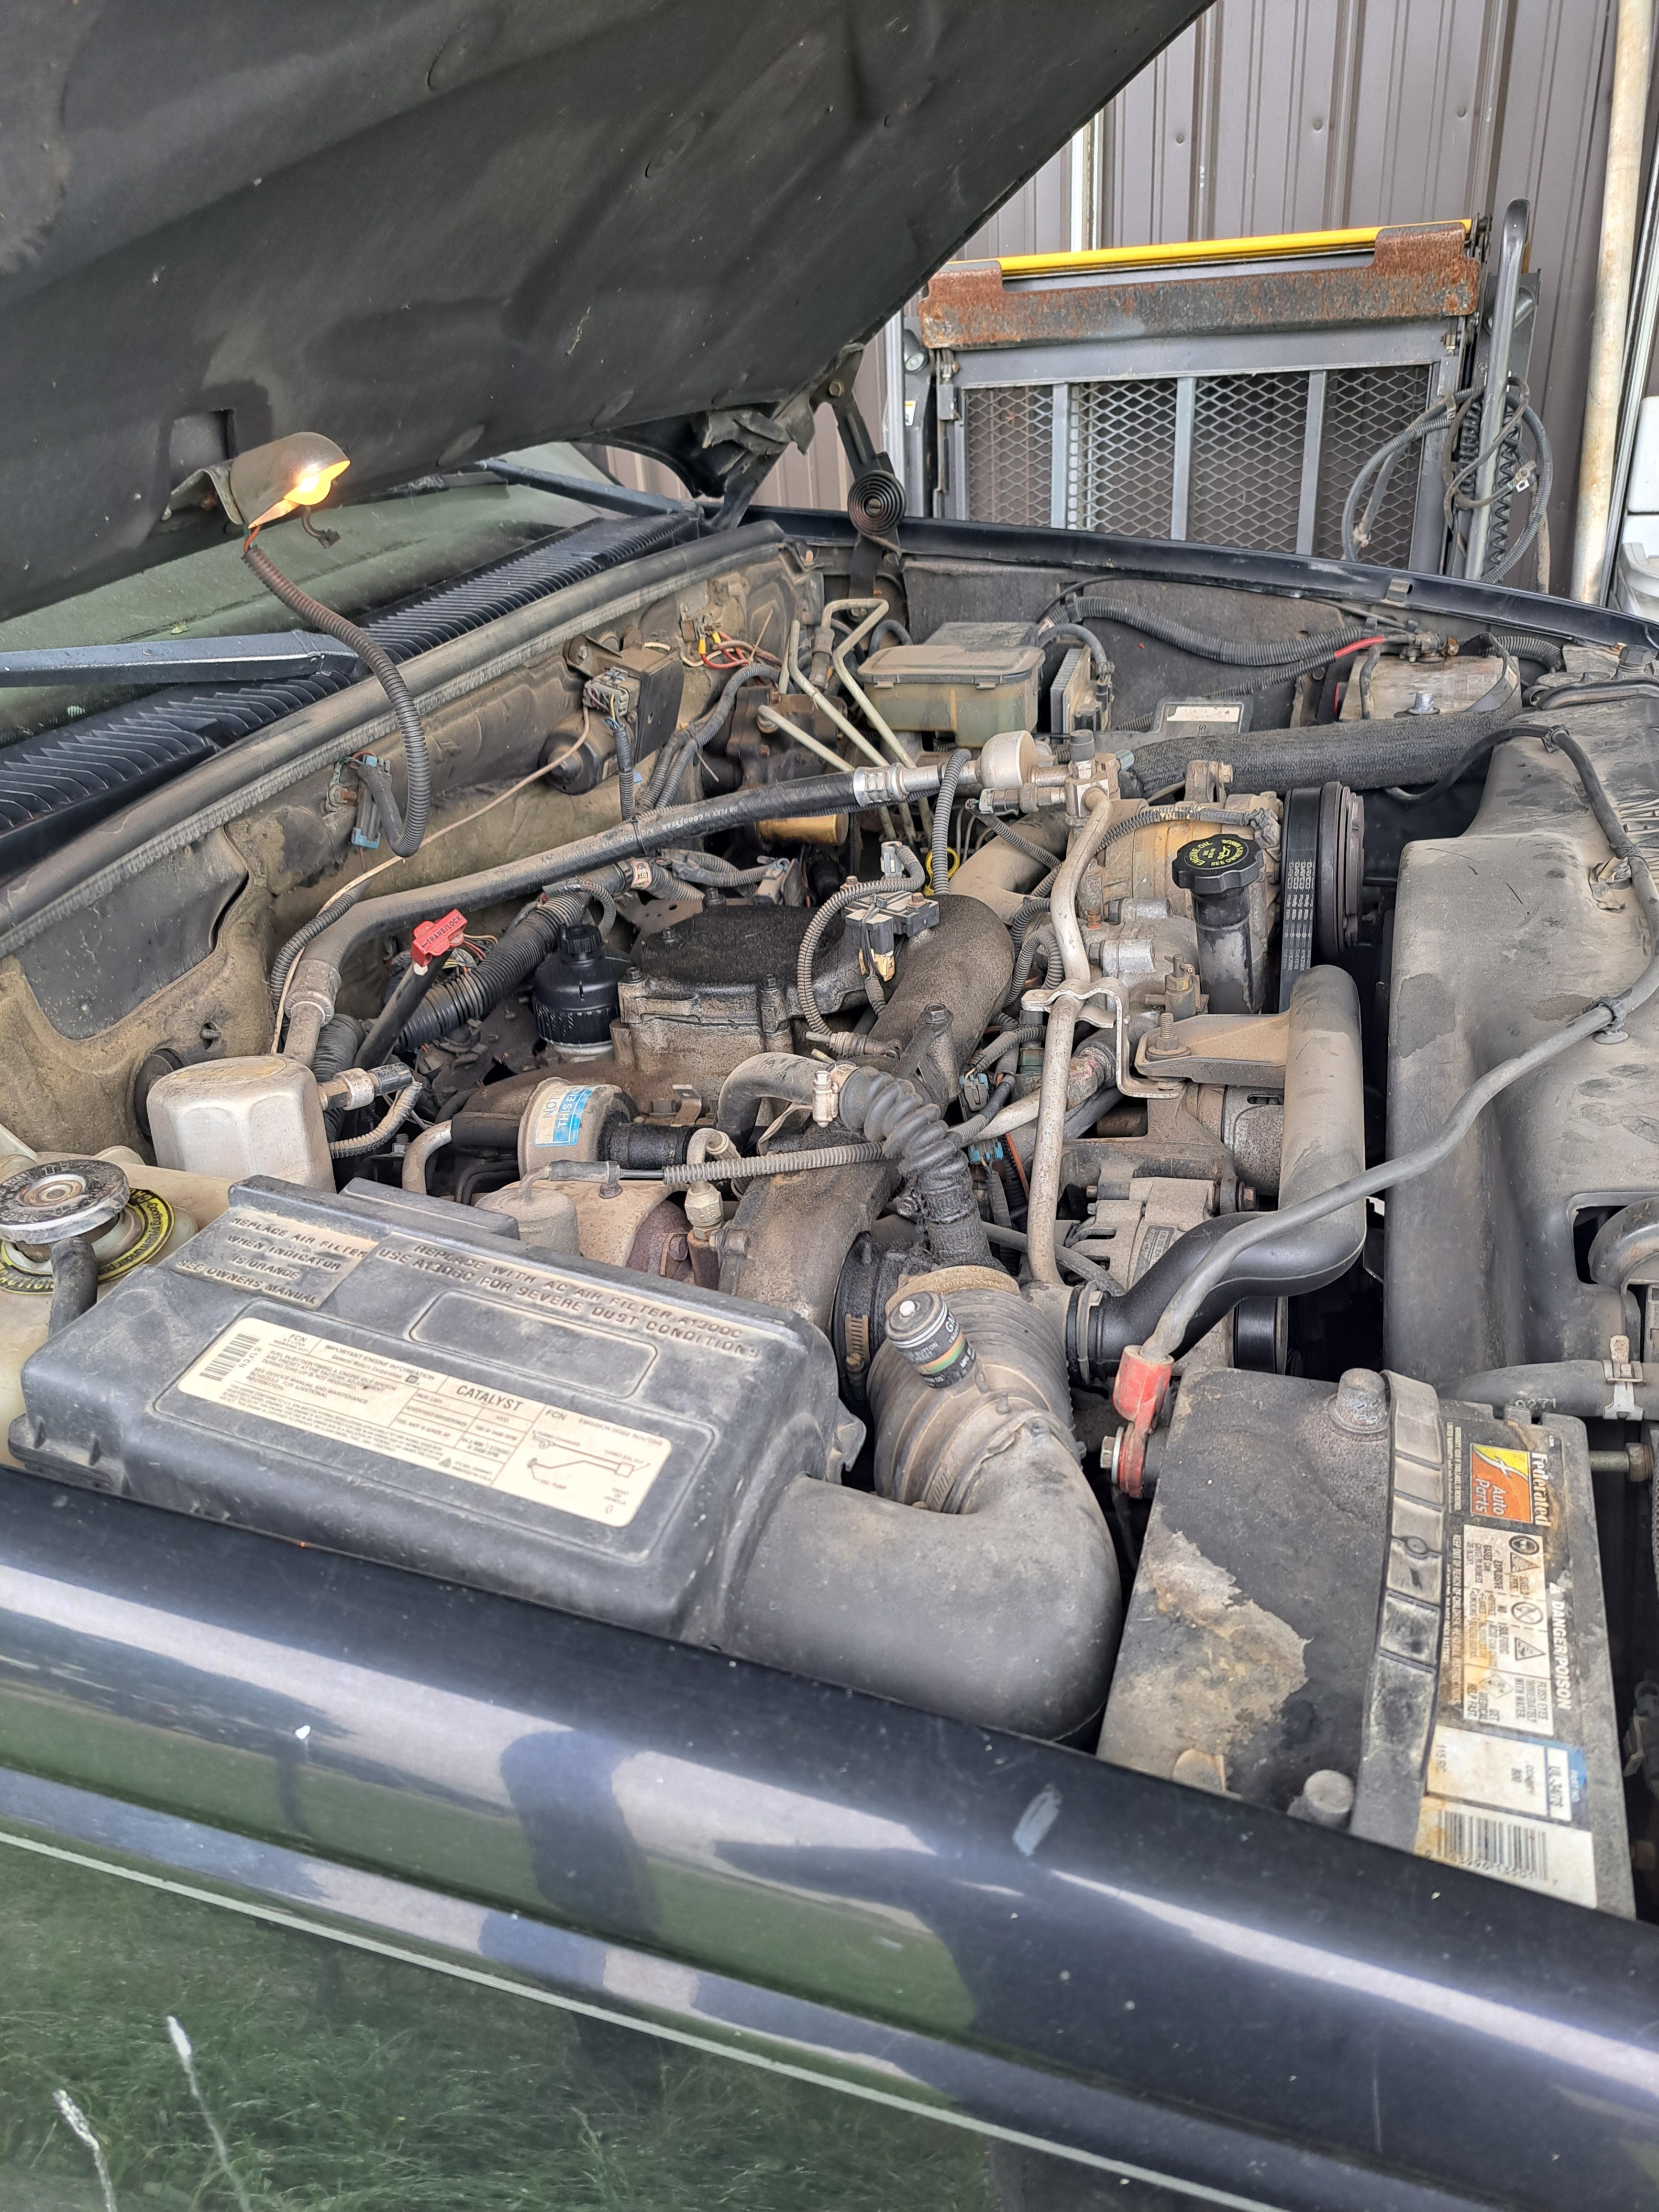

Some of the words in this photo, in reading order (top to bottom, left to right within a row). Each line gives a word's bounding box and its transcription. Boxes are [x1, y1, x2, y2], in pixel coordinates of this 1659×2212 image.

[662, 813, 704, 831] GOODYEAR
[1189, 848, 1206, 865] ENGINE
[426, 915, 463, 945] TRANS/LOCK
[557, 1104, 572, 1129] THIS
[146, 1203, 164, 1225] Cooling
[232, 1217, 288, 1237] REPLACE
[292, 1234, 315, 1245] AIR
[320, 1241, 368, 1258] FILTER
[227, 1236, 265, 1250] WHEN
[268, 1247, 341, 1270] INDICATOR
[232, 1255, 247, 1264] IS
[248, 1261, 300, 1279] ORANGE
[178, 1259, 205, 1272] SEE
[206, 1267, 263, 1288] OWNERS
[265, 1284, 317, 1304] MANUAL
[412, 1243, 487, 1270] REPLACE
[490, 1264, 537, 1284] WITH
[542, 1279, 568, 1293] AC
[574, 1286, 603, 1302] AIR
[608, 1296, 673, 1321] FILTER
[378, 1248, 412, 1264] USE
[479, 1275, 512, 1292] FOR
[516, 1285, 584, 1312] SEVERE
[590, 1305, 639, 1327] DUST
[645, 1319, 759, 1360] CONDITIONS
[288, 1333, 308, 1343] FCN
[323, 1344, 364, 1360] IMPORTANT
[362, 1356, 390, 1367] ENGINE
[388, 1363, 437, 1381] INFORMATION
[454, 1384, 525, 1412] CATALYST
[544, 1409, 568, 1420] FCN
[1474, 1478, 1490, 1513] Parts
[1492, 1485, 1508, 1515] Auto
[1531, 1452, 1552, 1527] Federated
[1483, 1544, 1492, 1561] GASES
[1493, 1559, 1503, 1590] EXPLOSIVE
[1519, 1576, 1529, 1595] SHIELD
[1498, 1604, 1506, 1613] NO
[1489, 1624, 1497, 1638] ACID
[1499, 1625, 1509, 1655] SULFURIC
[1550, 1599, 1572, 1712] DANGER/POISON
[1467, 1682, 1477, 1699] HELP
[1478, 1691, 1489, 1722] MEDICAL
